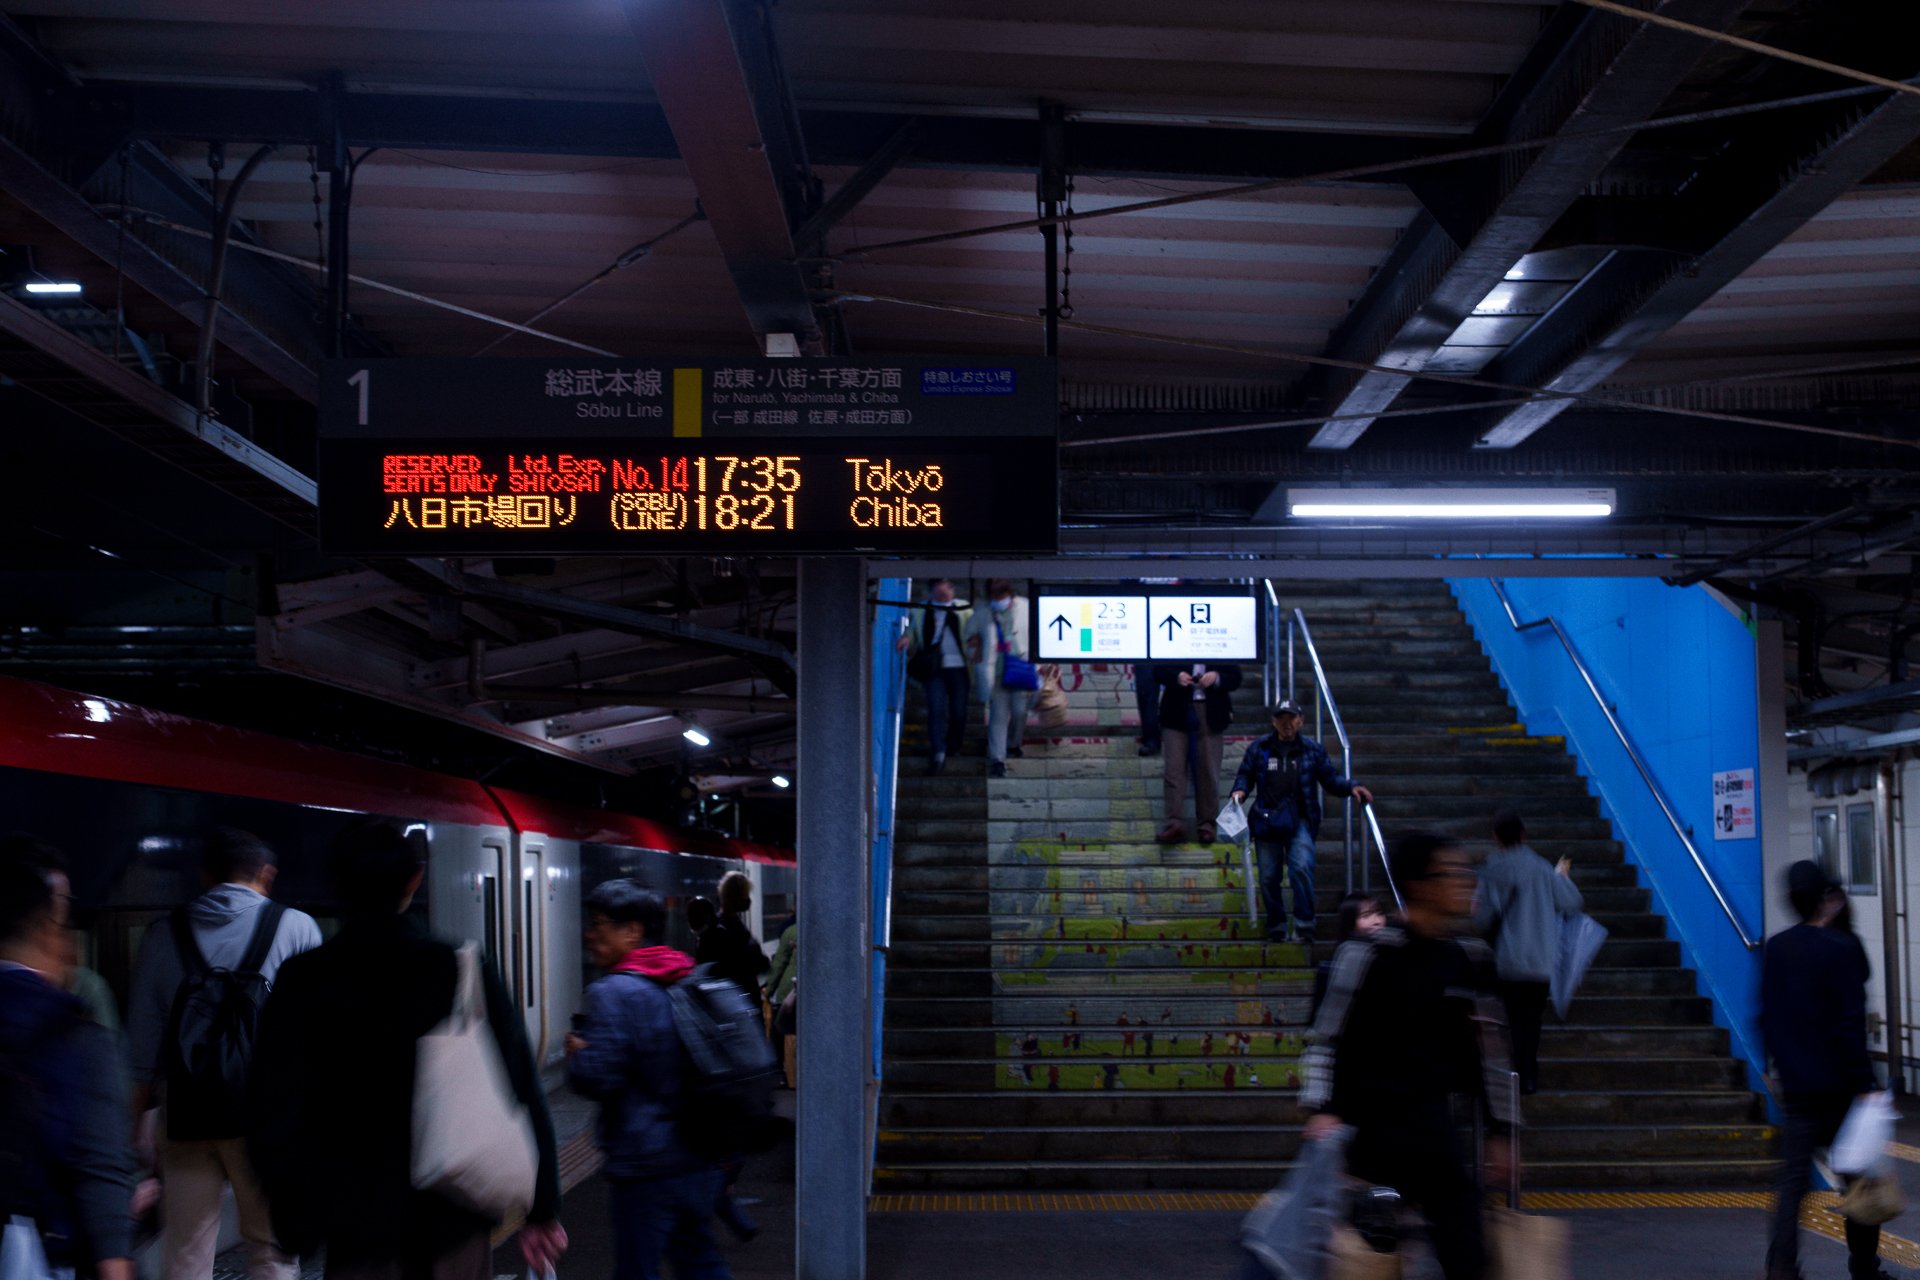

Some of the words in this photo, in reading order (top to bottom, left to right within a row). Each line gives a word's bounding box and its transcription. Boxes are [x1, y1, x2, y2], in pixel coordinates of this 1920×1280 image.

[545, 368, 663, 396] 総武本線
[924, 371, 1012, 383] 特急しおさい号
[347, 369, 370, 425] 1
[713, 393, 728, 403] for
[783, 392, 846, 403] Yachimata
[849, 393, 858, 403] &
[862, 392, 898, 403] Chiba
[577, 402, 620, 418] Sōbu
[627, 402, 663, 418] Line
[753, 411, 798, 424] 成田線
[383, 455, 482, 473] RESERVED
[694, 456, 801, 492] 17:35
[383, 475, 445, 493] SEATS
[450, 475, 498, 493] ONLY
[509, 475, 600, 492] SHIOSAI
[846, 458, 943, 494] Tōkyō
[384, 495, 577, 529] 八日市場回り
[694, 495, 795, 530] 18:21
[850, 497, 943, 527] Chiba
